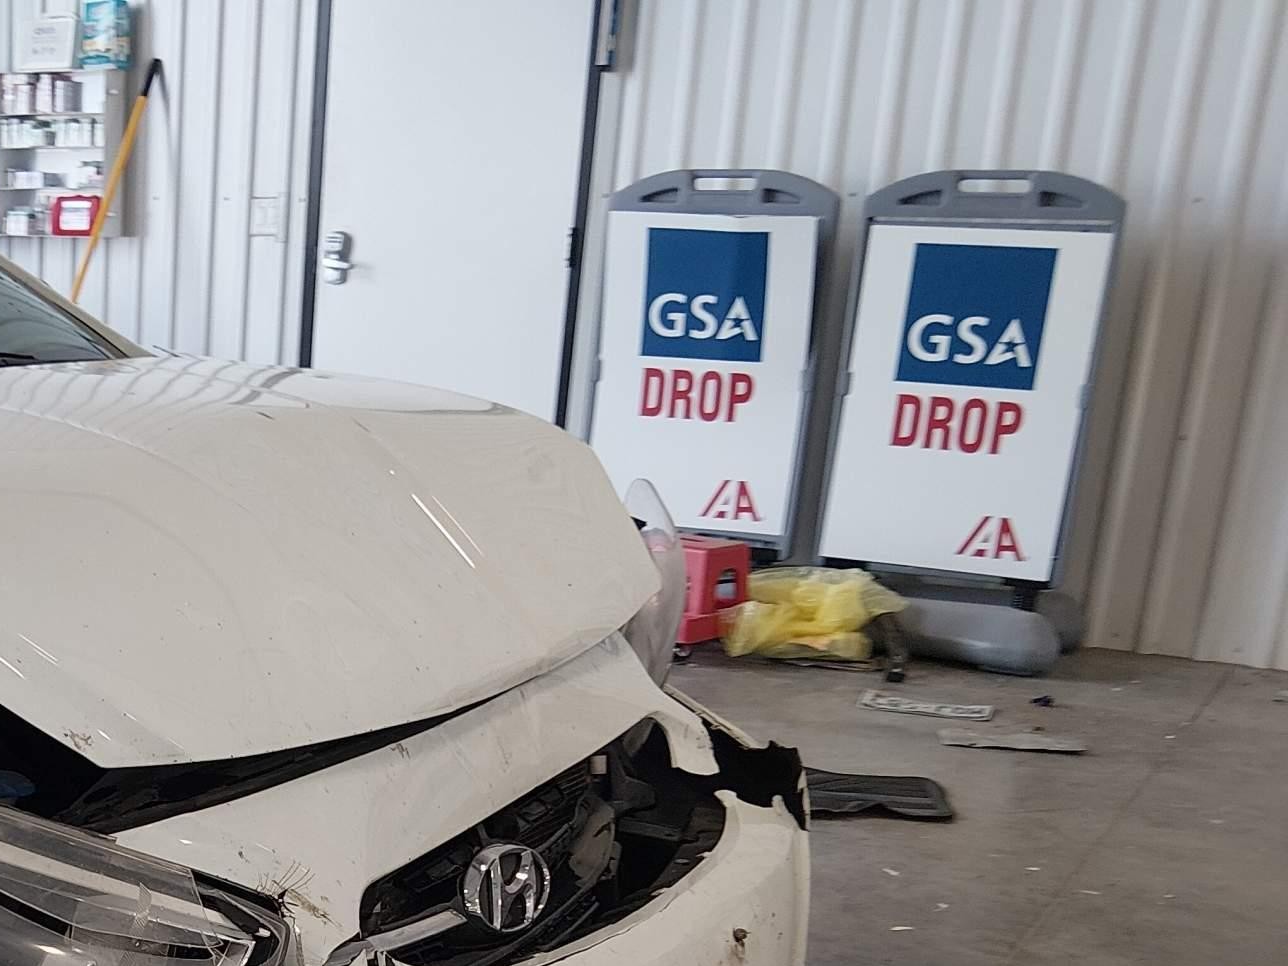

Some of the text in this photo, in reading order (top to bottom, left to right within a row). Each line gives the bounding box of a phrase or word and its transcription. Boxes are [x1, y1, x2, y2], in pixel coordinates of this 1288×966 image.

[648, 292, 758, 342] GSA
[906, 313, 1032, 369] GSA
[639, 367, 754, 423] DROP
[890, 394, 1024, 455] DROP
